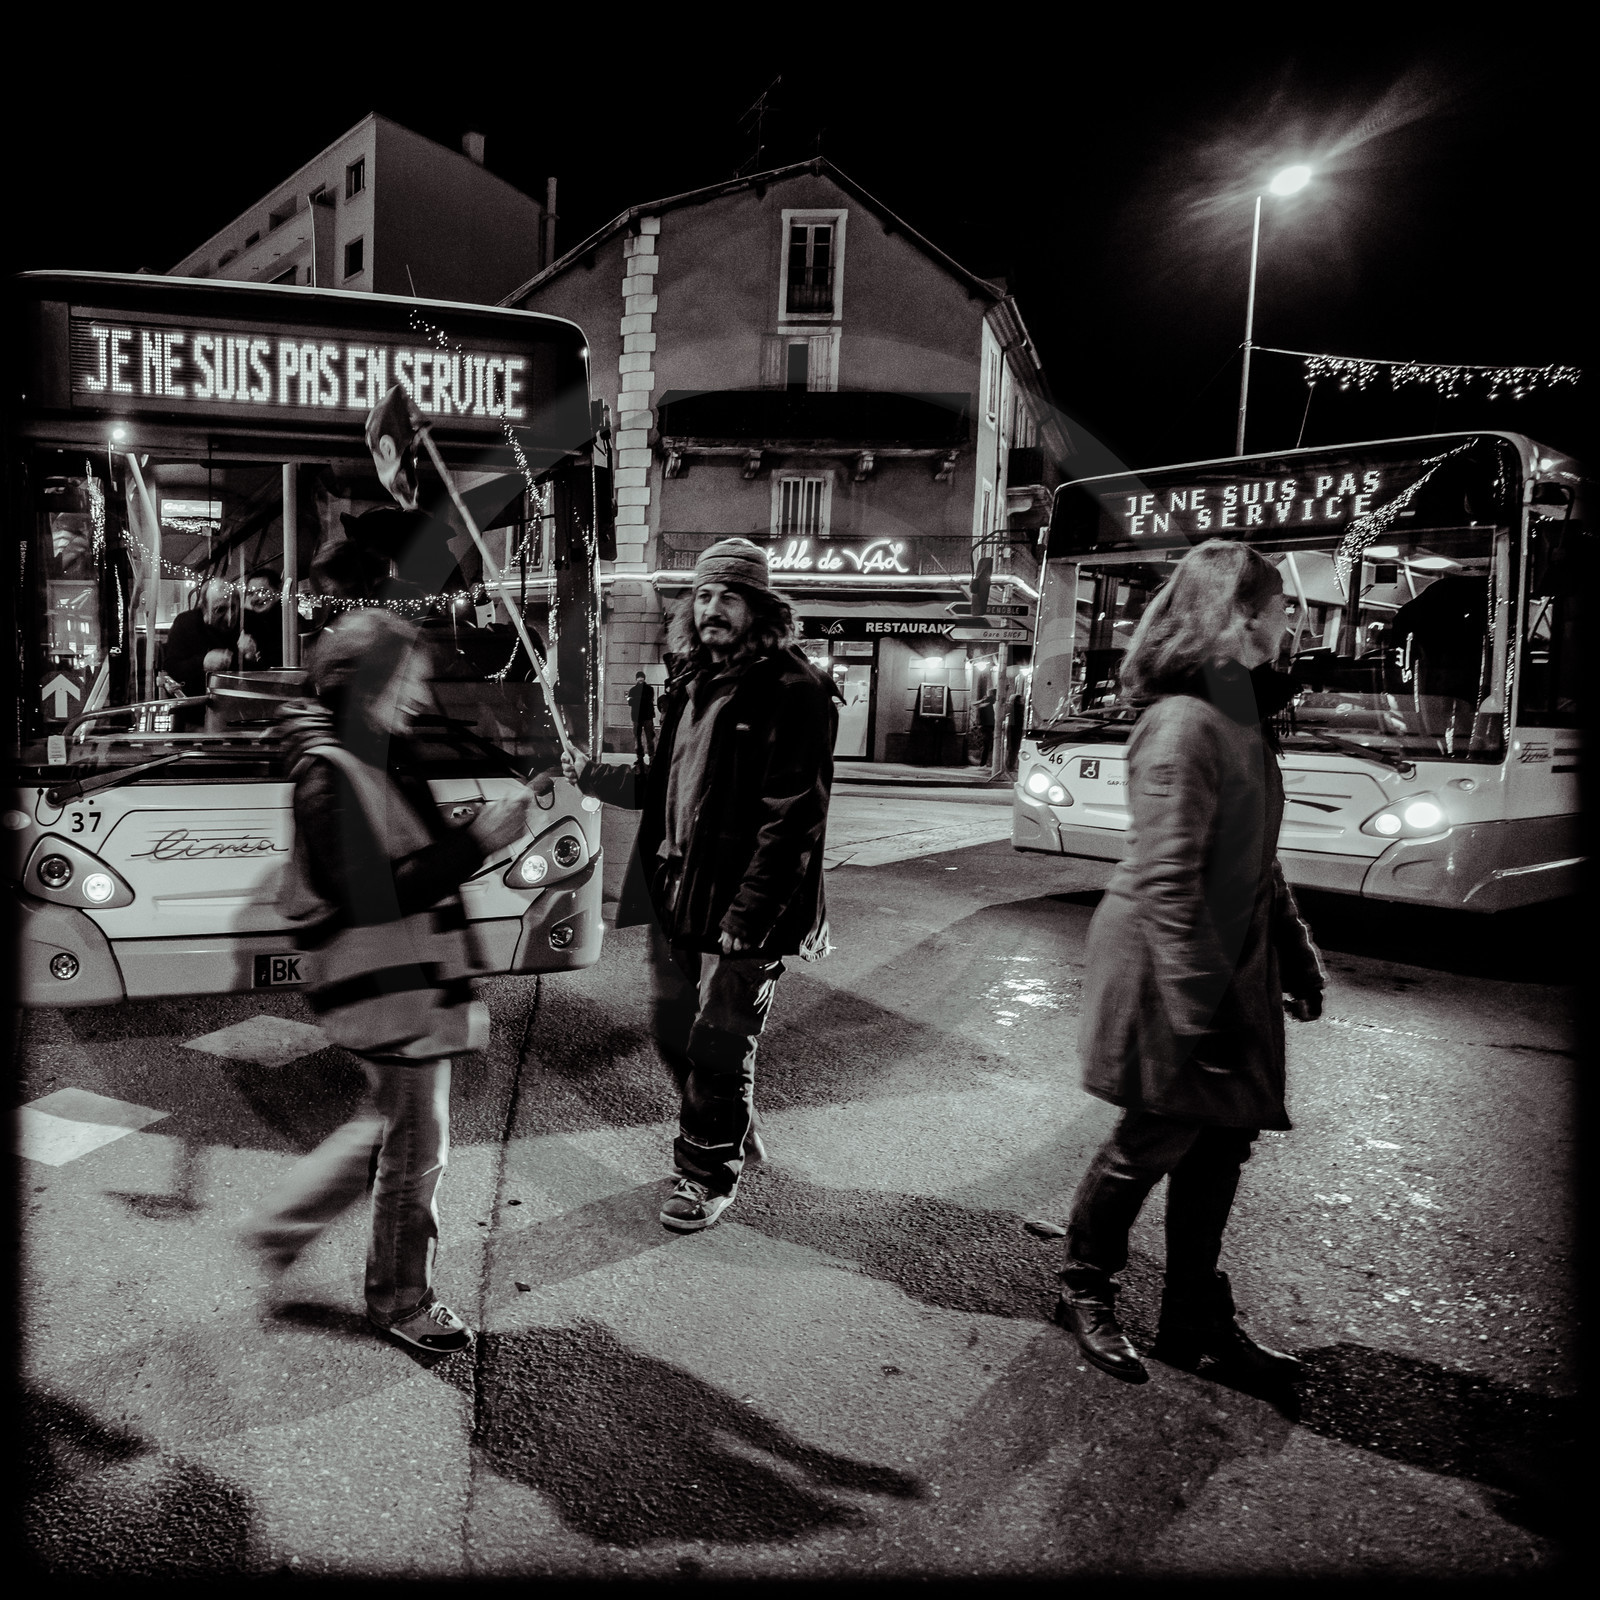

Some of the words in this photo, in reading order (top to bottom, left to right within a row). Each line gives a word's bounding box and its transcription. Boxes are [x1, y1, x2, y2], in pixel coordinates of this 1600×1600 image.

[87, 328, 132, 392] JE
[142, 331, 185, 396] NE
[194, 335, 270, 401] SUIS
[279, 342, 339, 406] PAS
[347, 348, 387, 408] EN
[394, 352, 524, 417] SERVICE
[1125, 494, 1155, 517] JE
[1170, 489, 1206, 512] NE
[1223, 479, 1297, 507] SUIS
[1316, 470, 1381, 498] PAS
[1131, 512, 1170, 535] EN
[1197, 493, 1373, 530] SERVICE
[818, 549, 843, 569] de
[985, 606, 1020, 615] RENOBLE
[1048, 753, 1063, 765] 46
[71, 811, 102, 833] 37
[272, 958, 302, 981] BK
